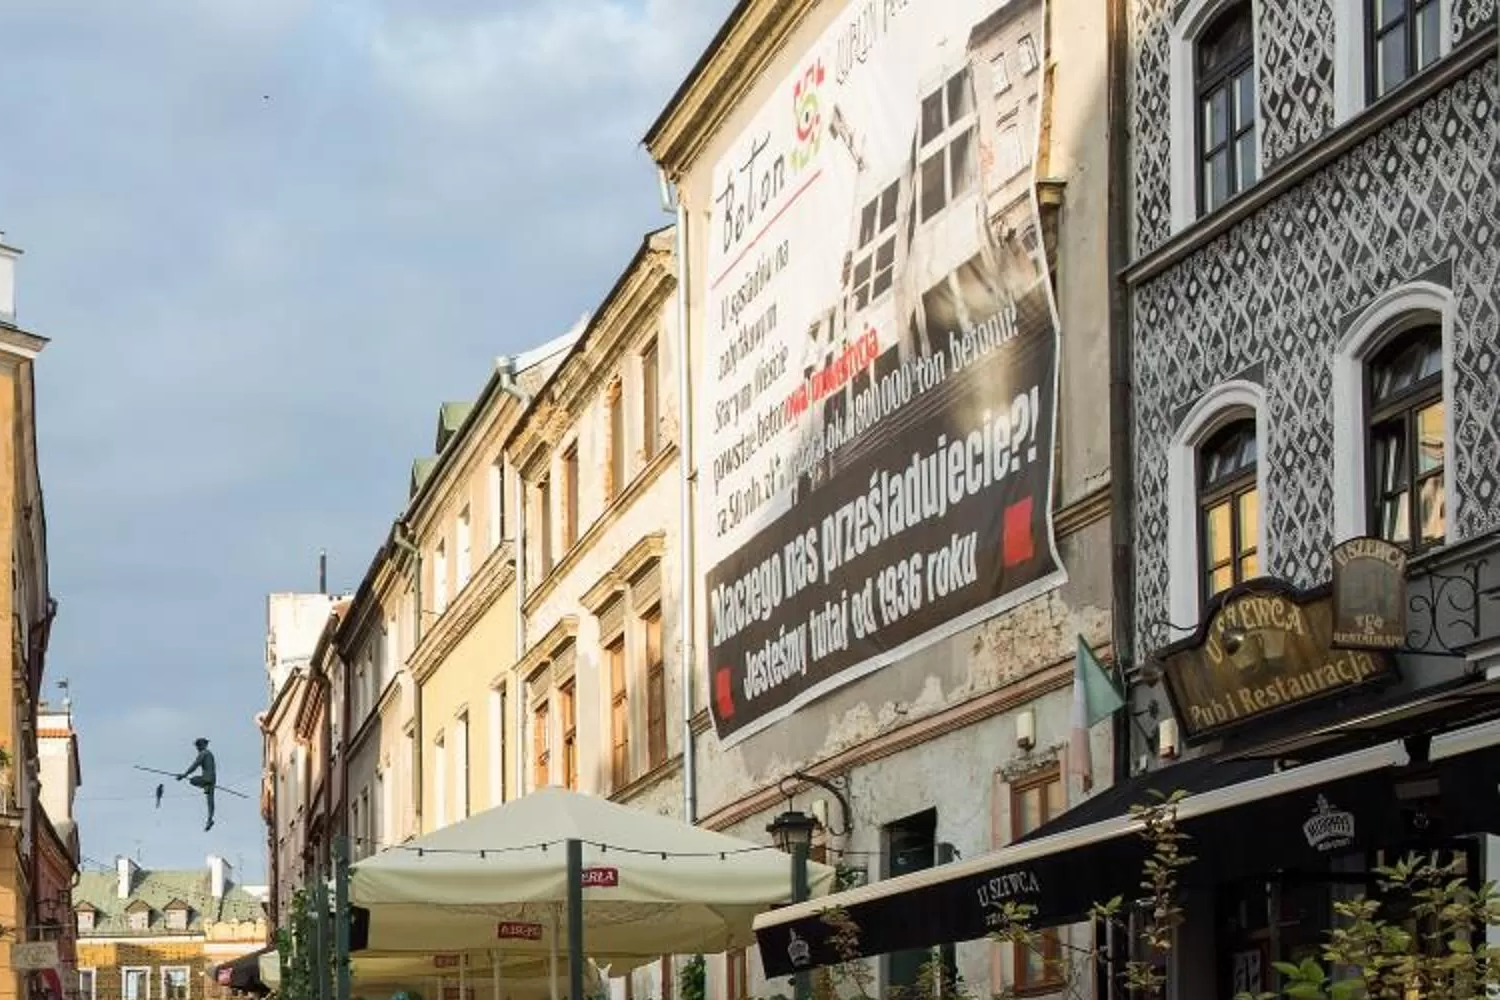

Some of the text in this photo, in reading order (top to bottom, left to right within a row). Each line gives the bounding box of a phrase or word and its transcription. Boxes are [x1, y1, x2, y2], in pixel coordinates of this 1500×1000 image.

[915, 350, 946, 394] ton
[784, 527, 819, 598] nas
[810, 588, 848, 662] tutaj
[851, 577, 877, 639] od
[876, 552, 923, 626] 1936
[927, 532, 978, 603] roku
[1190, 700, 1227, 731] Pub
[1237, 650, 1376, 712] Restauracja
